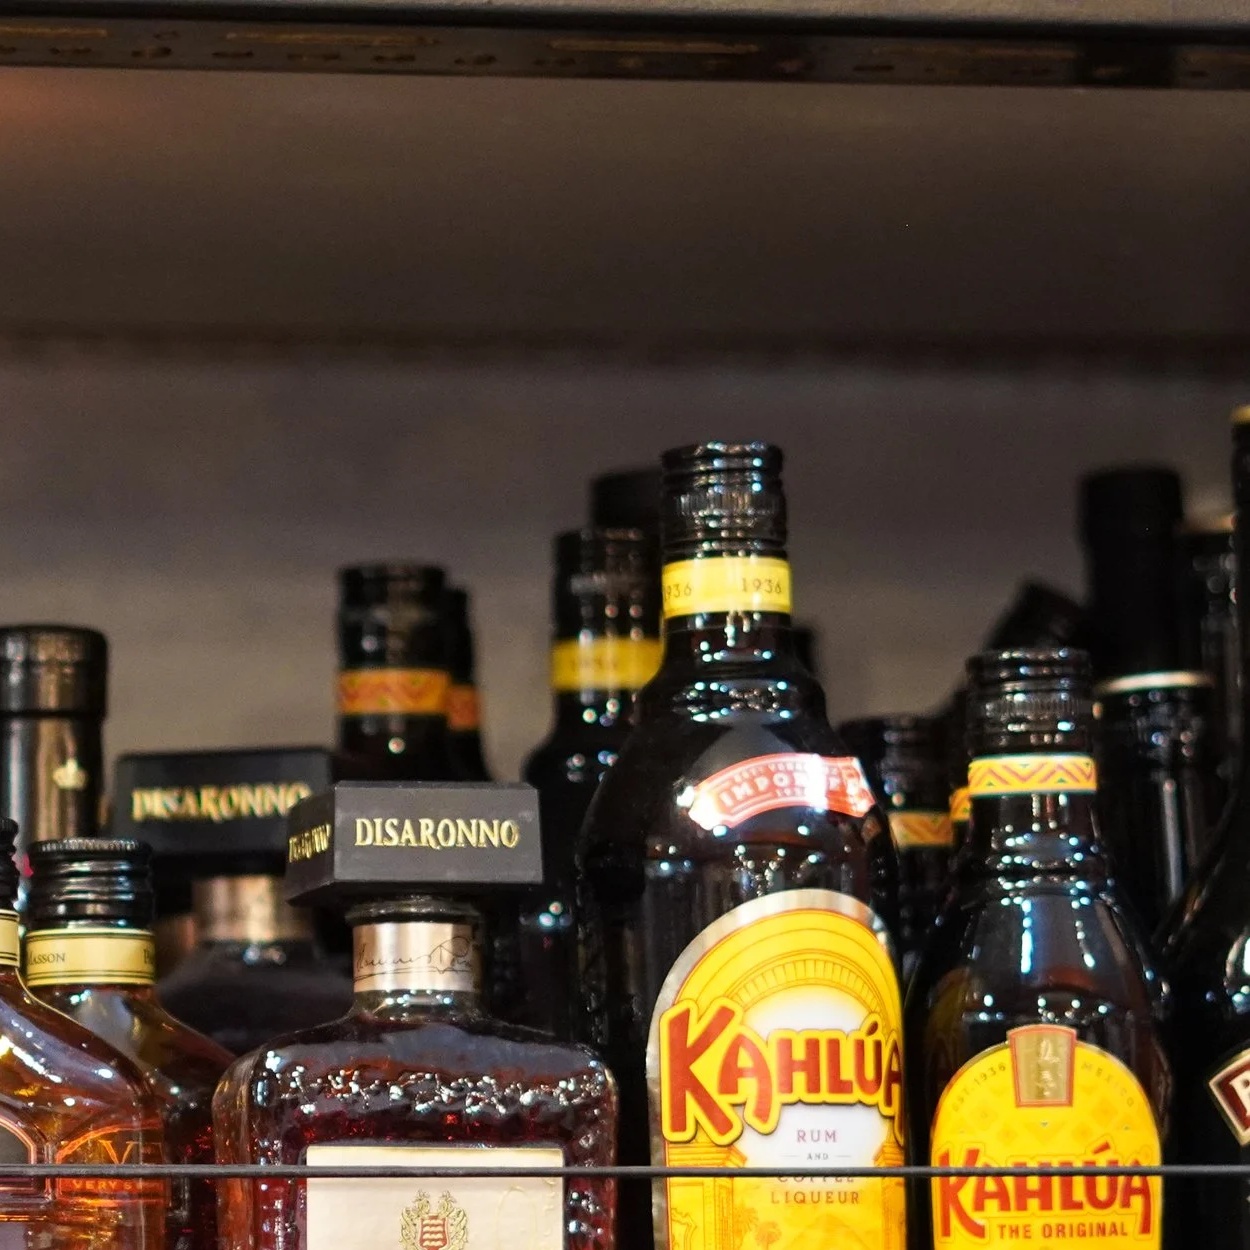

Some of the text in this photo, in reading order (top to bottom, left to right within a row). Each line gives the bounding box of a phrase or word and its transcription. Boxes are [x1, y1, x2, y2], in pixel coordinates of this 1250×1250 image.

[741, 577, 782, 595] 1936
[354, 817, 520, 850] DISARONNO
[663, 1005, 903, 1137] KAHLÚA
[796, 1129, 838, 1143] RUM
[806, 1152, 829, 1161] AND
[770, 1191, 860, 1205] LIQUEUR
[938, 1141, 1151, 1239] KAHLÚA
[997, 1221, 1128, 1240] THE ORIGINAL
